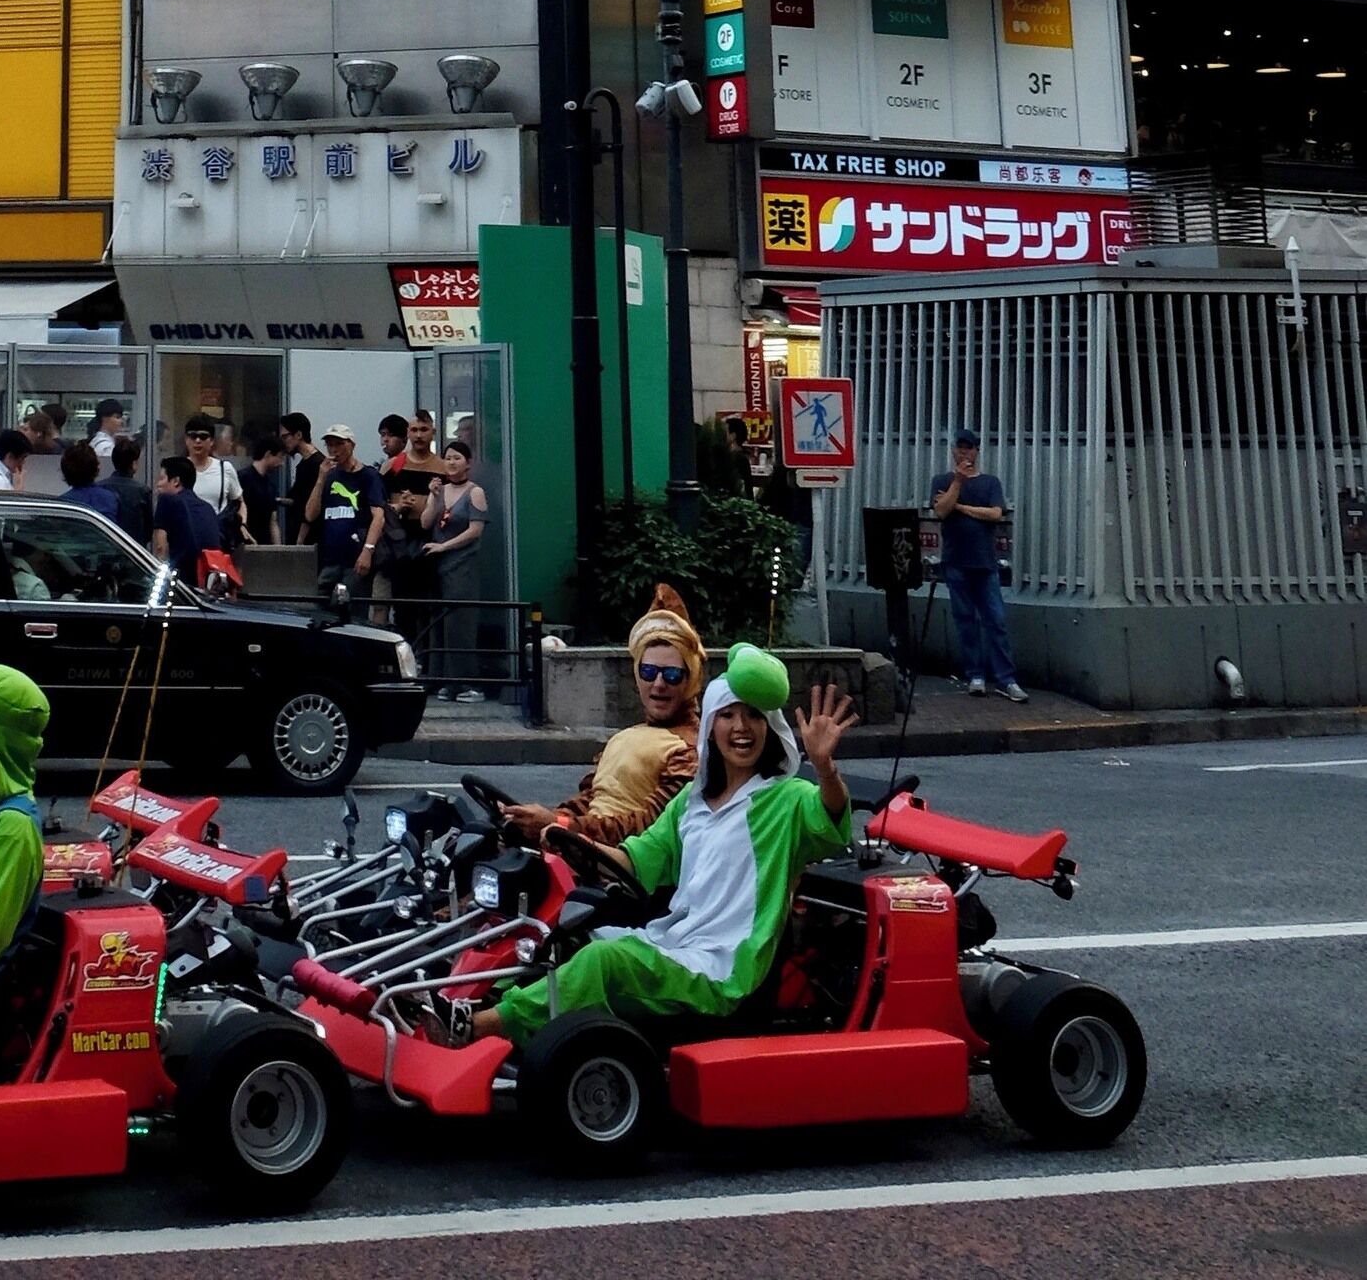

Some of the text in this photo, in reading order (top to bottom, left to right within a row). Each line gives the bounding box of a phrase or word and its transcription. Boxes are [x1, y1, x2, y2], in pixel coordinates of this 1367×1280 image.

[775, 1, 803, 15] Care
[1011, 0, 1061, 16] Kanebo
[719, 27, 734, 47] 2F
[898, 63, 925, 87] 2F
[1027, 72, 1053, 96] 3F
[722, 85, 735, 106] 1F
[778, 87, 813, 102] STORE
[887, 94, 940, 111] COSMETIC
[718, 109, 739, 122] DRUG
[1015, 103, 1068, 120] COSMETIC
[718, 122, 740, 136] STORE
[139, 136, 486, 182] 渋谷駅前ビル
[790, 152, 946, 178] TAX FREE SHOP
[998, 164, 1062, 185] 尚都乐客
[767, 197, 1091, 262] 薬 サンドラッグ
[149, 322, 364, 340] SHIBUYA EKIMAE
[324, 506, 356, 520] PUMA
[118, 668, 149, 680] TXI
[72, 1030, 151, 1053] MariCar.com
